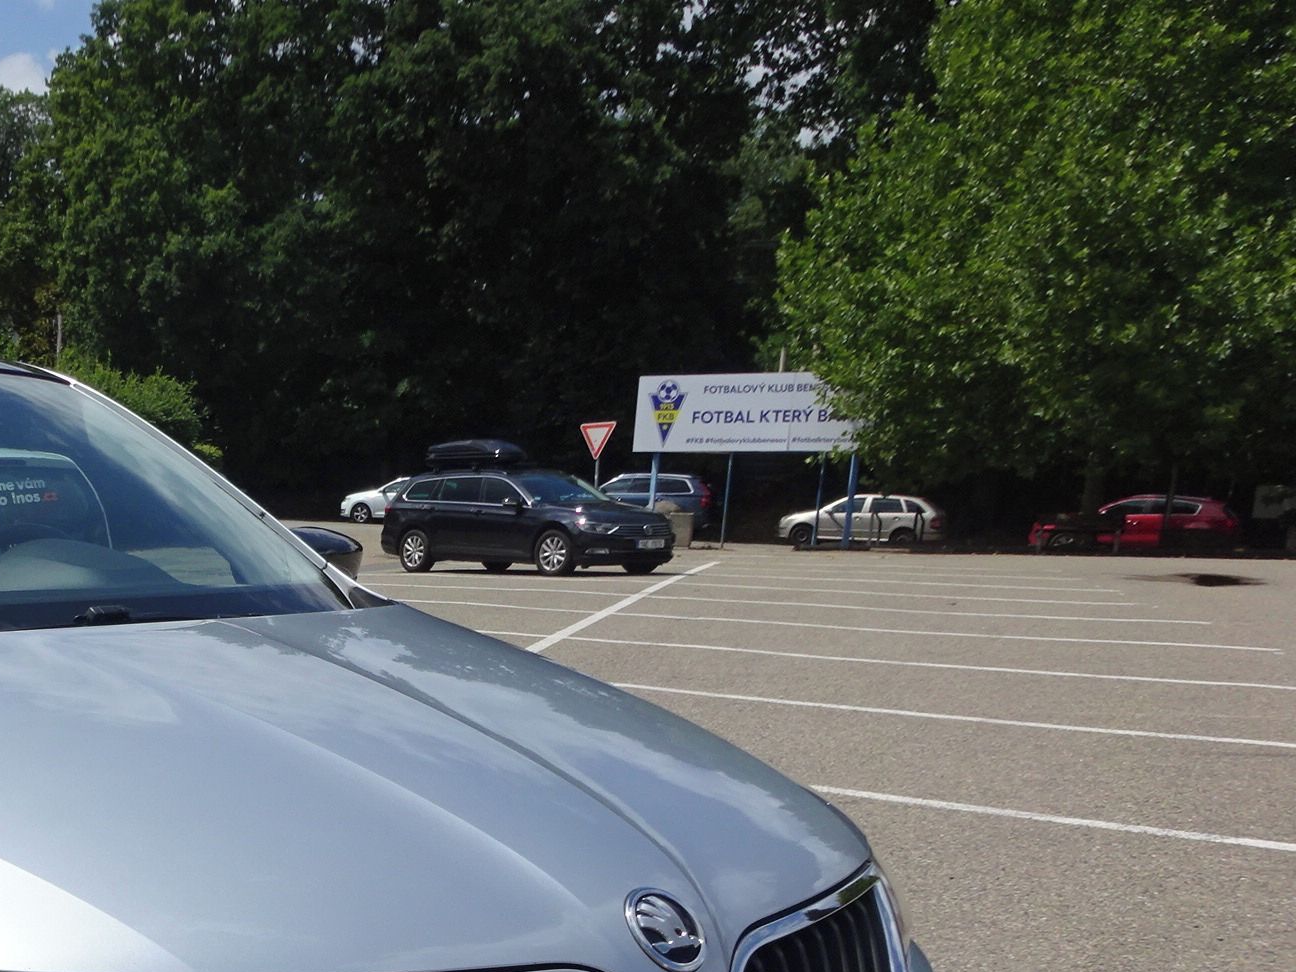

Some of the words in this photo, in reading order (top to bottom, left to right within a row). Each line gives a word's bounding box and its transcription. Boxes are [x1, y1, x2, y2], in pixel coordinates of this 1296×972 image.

[704, 382, 765, 394] FOTBALOVÝ
[767, 383, 795, 393] KLUB
[657, 412, 675, 421] FKB
[691, 410, 755, 424] FOTBAL
[759, 405, 813, 423] KTERÝ
[15, 477, 46, 490] vám
